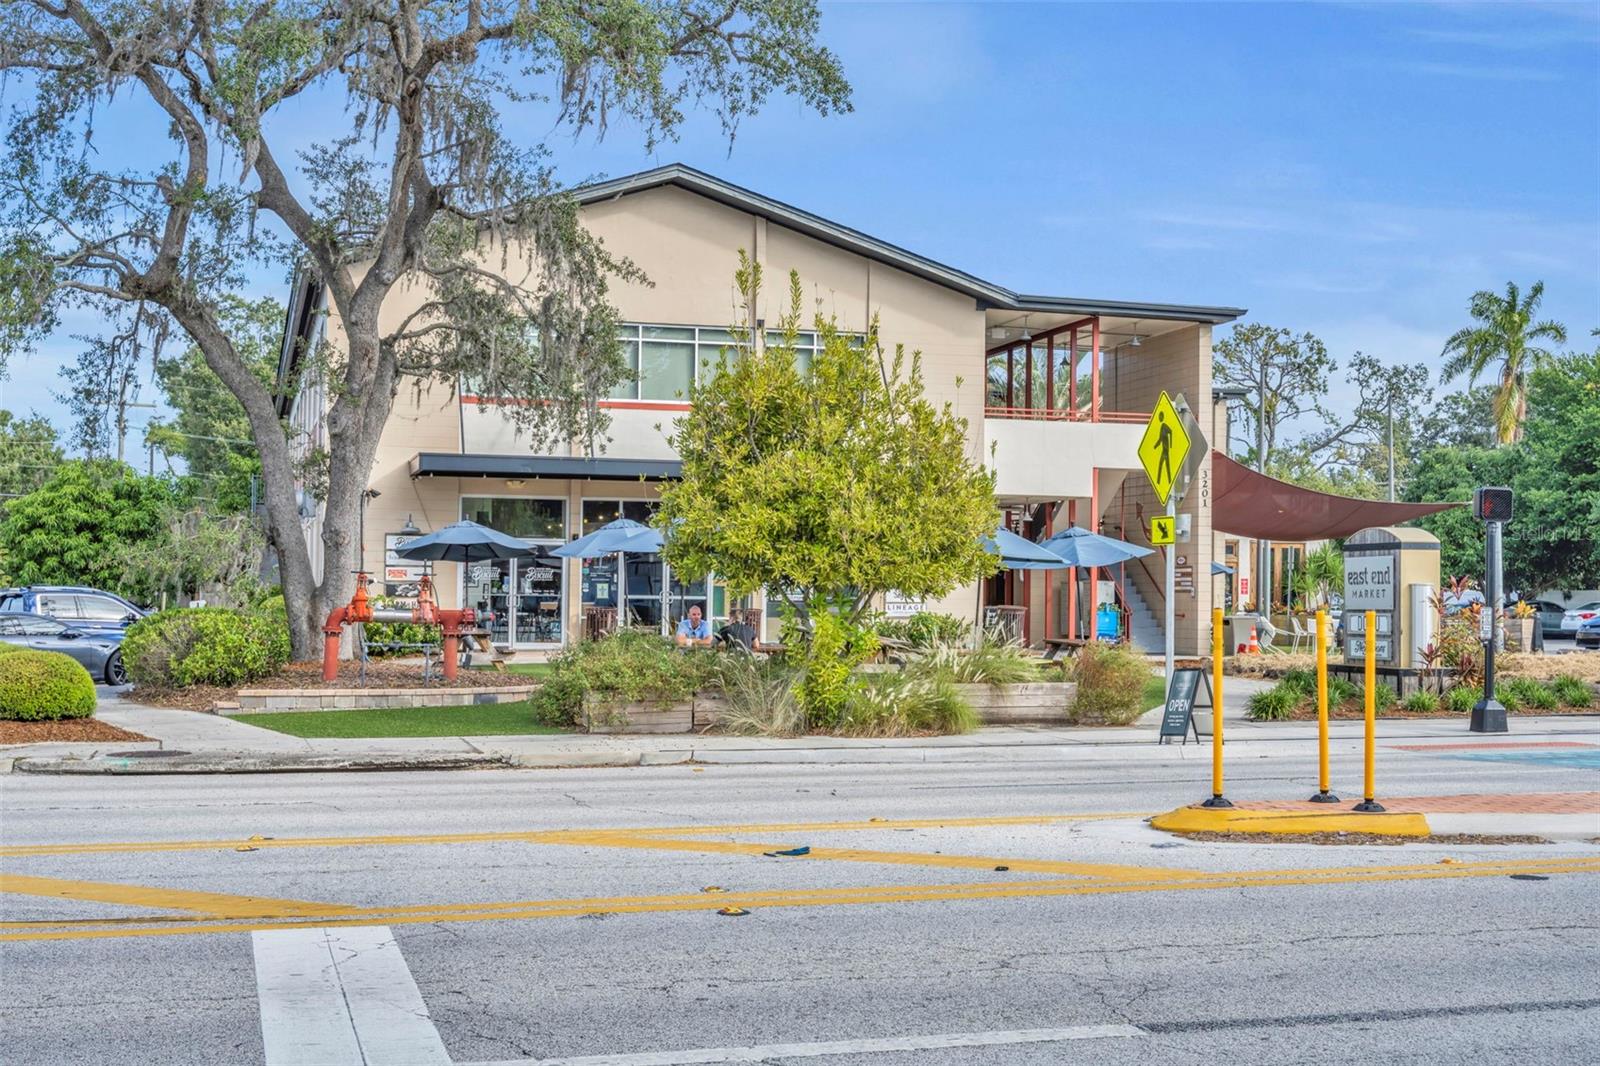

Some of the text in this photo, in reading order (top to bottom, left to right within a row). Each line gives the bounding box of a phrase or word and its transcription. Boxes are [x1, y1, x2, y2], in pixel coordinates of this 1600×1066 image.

[1201, 470, 1209, 508] 3201
[472, 566, 501, 581] Biscuit
[525, 567, 554, 582] Biscuit
[1347, 566, 1391, 585] east end
[1352, 589, 1387, 599] MARKET
[1168, 699, 1190, 712] OPEN
